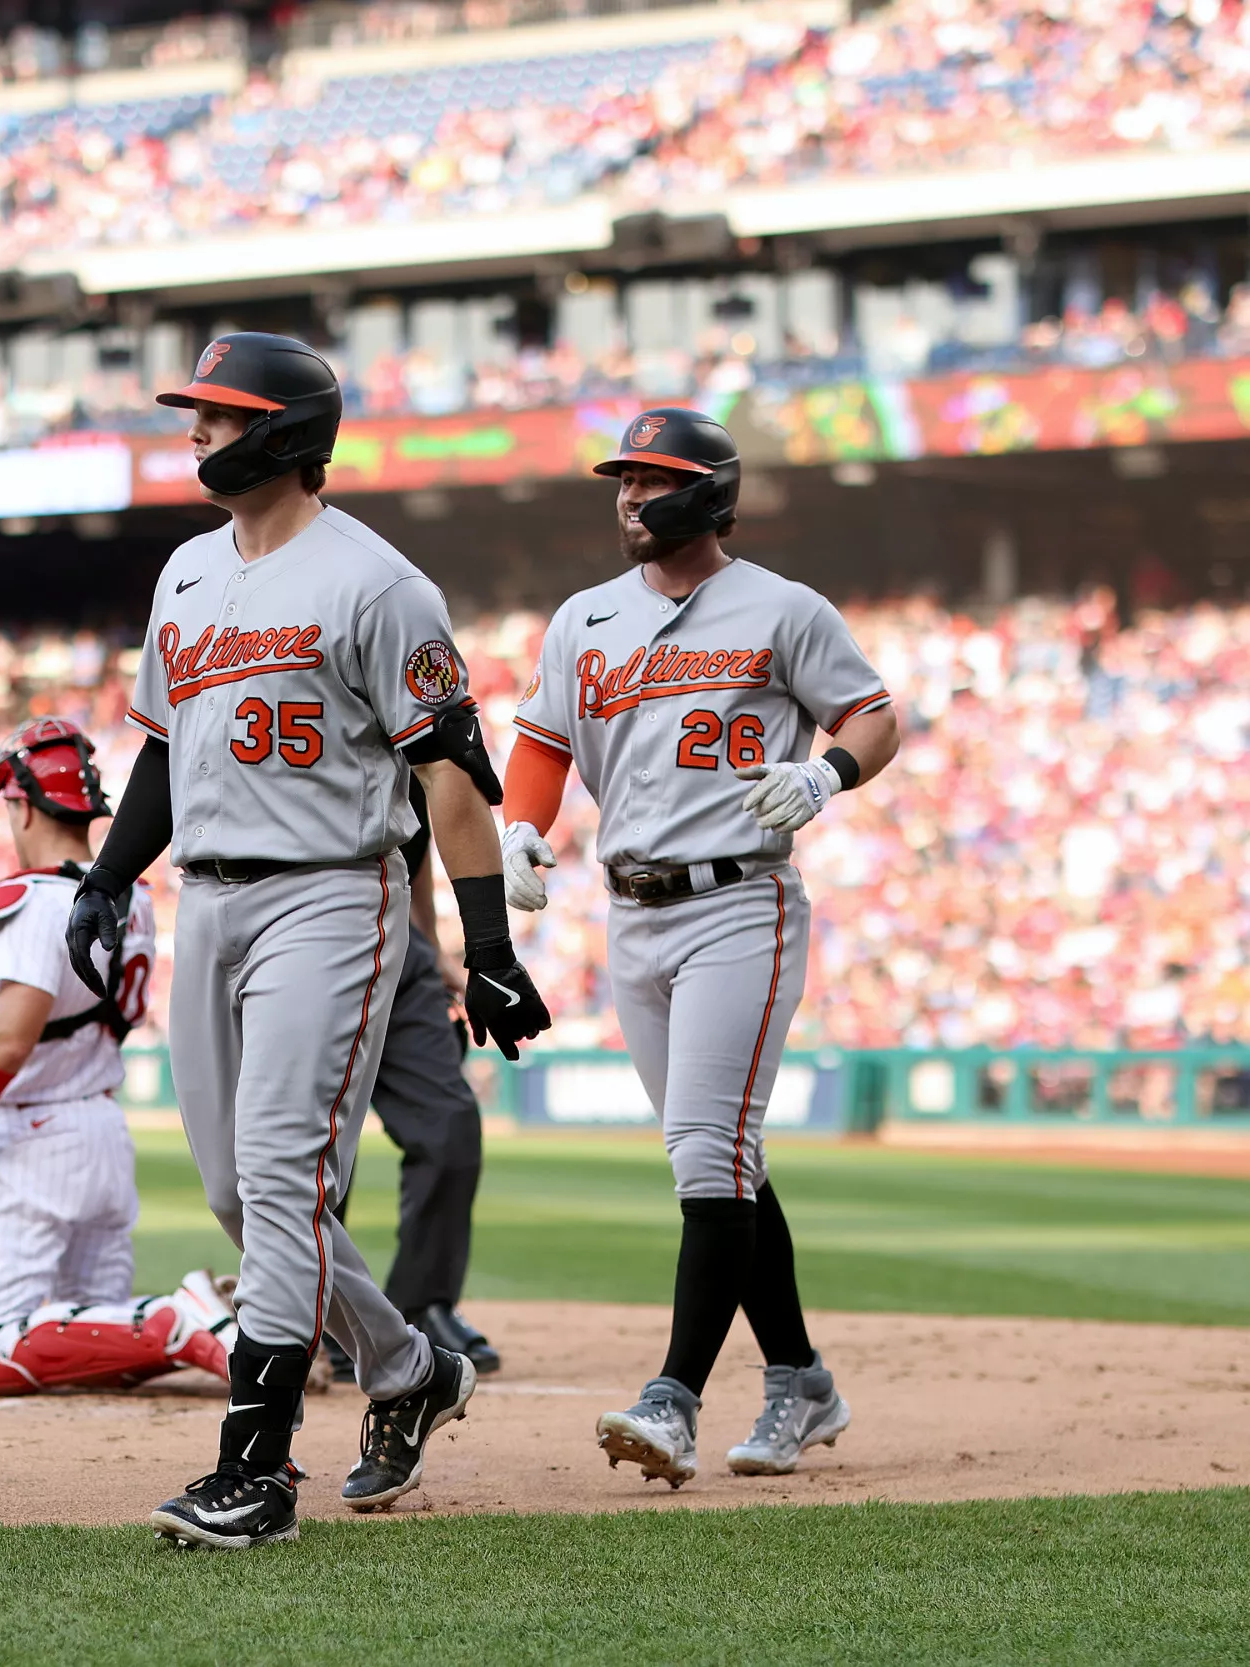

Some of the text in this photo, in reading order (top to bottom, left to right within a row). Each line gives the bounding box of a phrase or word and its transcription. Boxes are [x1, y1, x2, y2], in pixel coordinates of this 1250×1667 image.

[158, 621, 324, 695] Baltimore
[421, 683, 457, 704] ORIOLES
[576, 645, 773, 720] Baltimore
[229, 696, 325, 769] 35
[676, 708, 765, 771] 26
